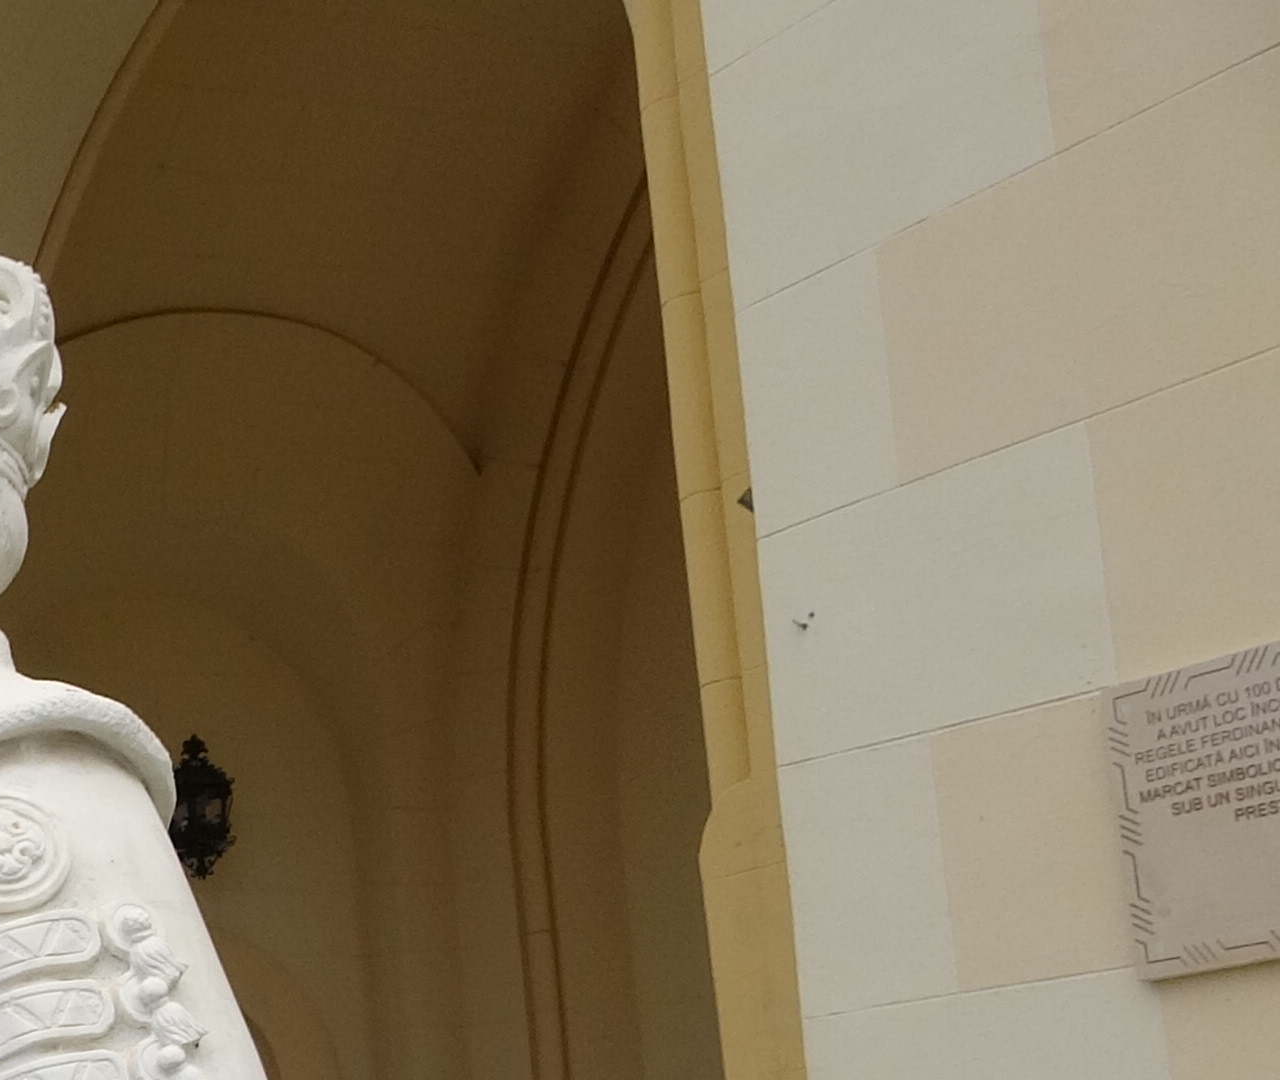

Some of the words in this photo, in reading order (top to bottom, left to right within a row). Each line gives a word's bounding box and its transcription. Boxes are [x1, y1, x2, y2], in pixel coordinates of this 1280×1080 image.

[1216, 689, 1239, 707] CU
[1244, 681, 1271, 699] 100
[1156, 728, 1167, 741] A
[1169, 716, 1208, 738] AVUT
[1213, 707, 1246, 727] LOC
[1134, 739, 1197, 765] REGELE
[1229, 744, 1259, 763] AICI
[1139, 777, 1202, 803] MARCAT
[1171, 797, 1203, 816] SUB
[1207, 791, 1230, 808] UN
